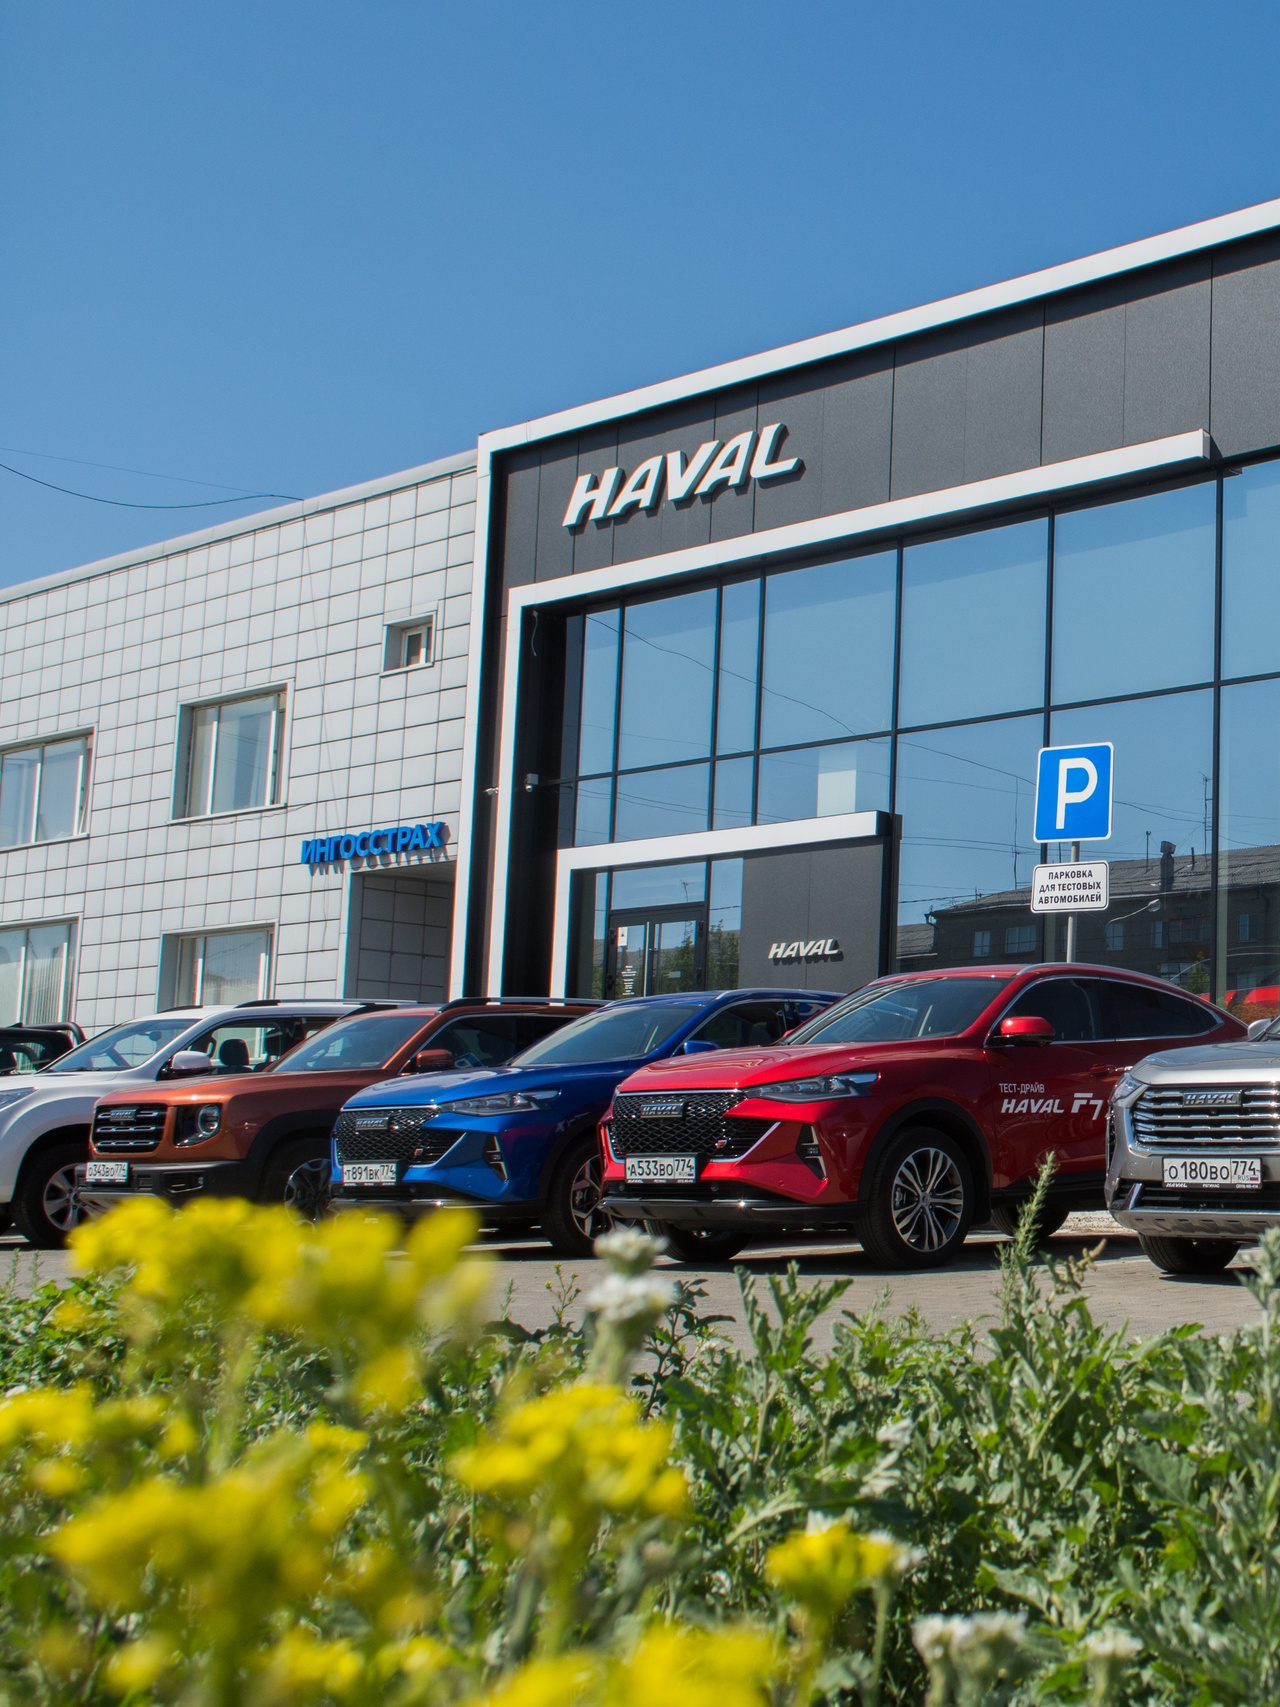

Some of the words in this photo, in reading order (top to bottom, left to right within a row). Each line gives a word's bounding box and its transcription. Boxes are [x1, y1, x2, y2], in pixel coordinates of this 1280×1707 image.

[562, 422, 803, 527] HAVAL
[1056, 757, 1098, 829] P
[301, 821, 446, 865] ИНГОССТРАХ
[1048, 869, 1093, 880] ПАРКОВКА
[1039, 884, 1056, 894] ДЛЯ
[1057, 881, 1102, 892] ТЕСТОВЫХ
[1038, 892, 1102, 905] АВТОМОБИЛЕЙ
[768, 938, 840, 959] HAVAL
[999, 1082, 1046, 1095] ТЕСТ-ДРАЙВ
[1000, 1098, 1065, 1114] HAVAL
[1185, 1093, 1238, 1105] HAVAL
[675, 1159, 693, 1172] 774
[1168, 1161, 1230, 1180] О180ВО
[1232, 1160, 1257, 1175] 774
